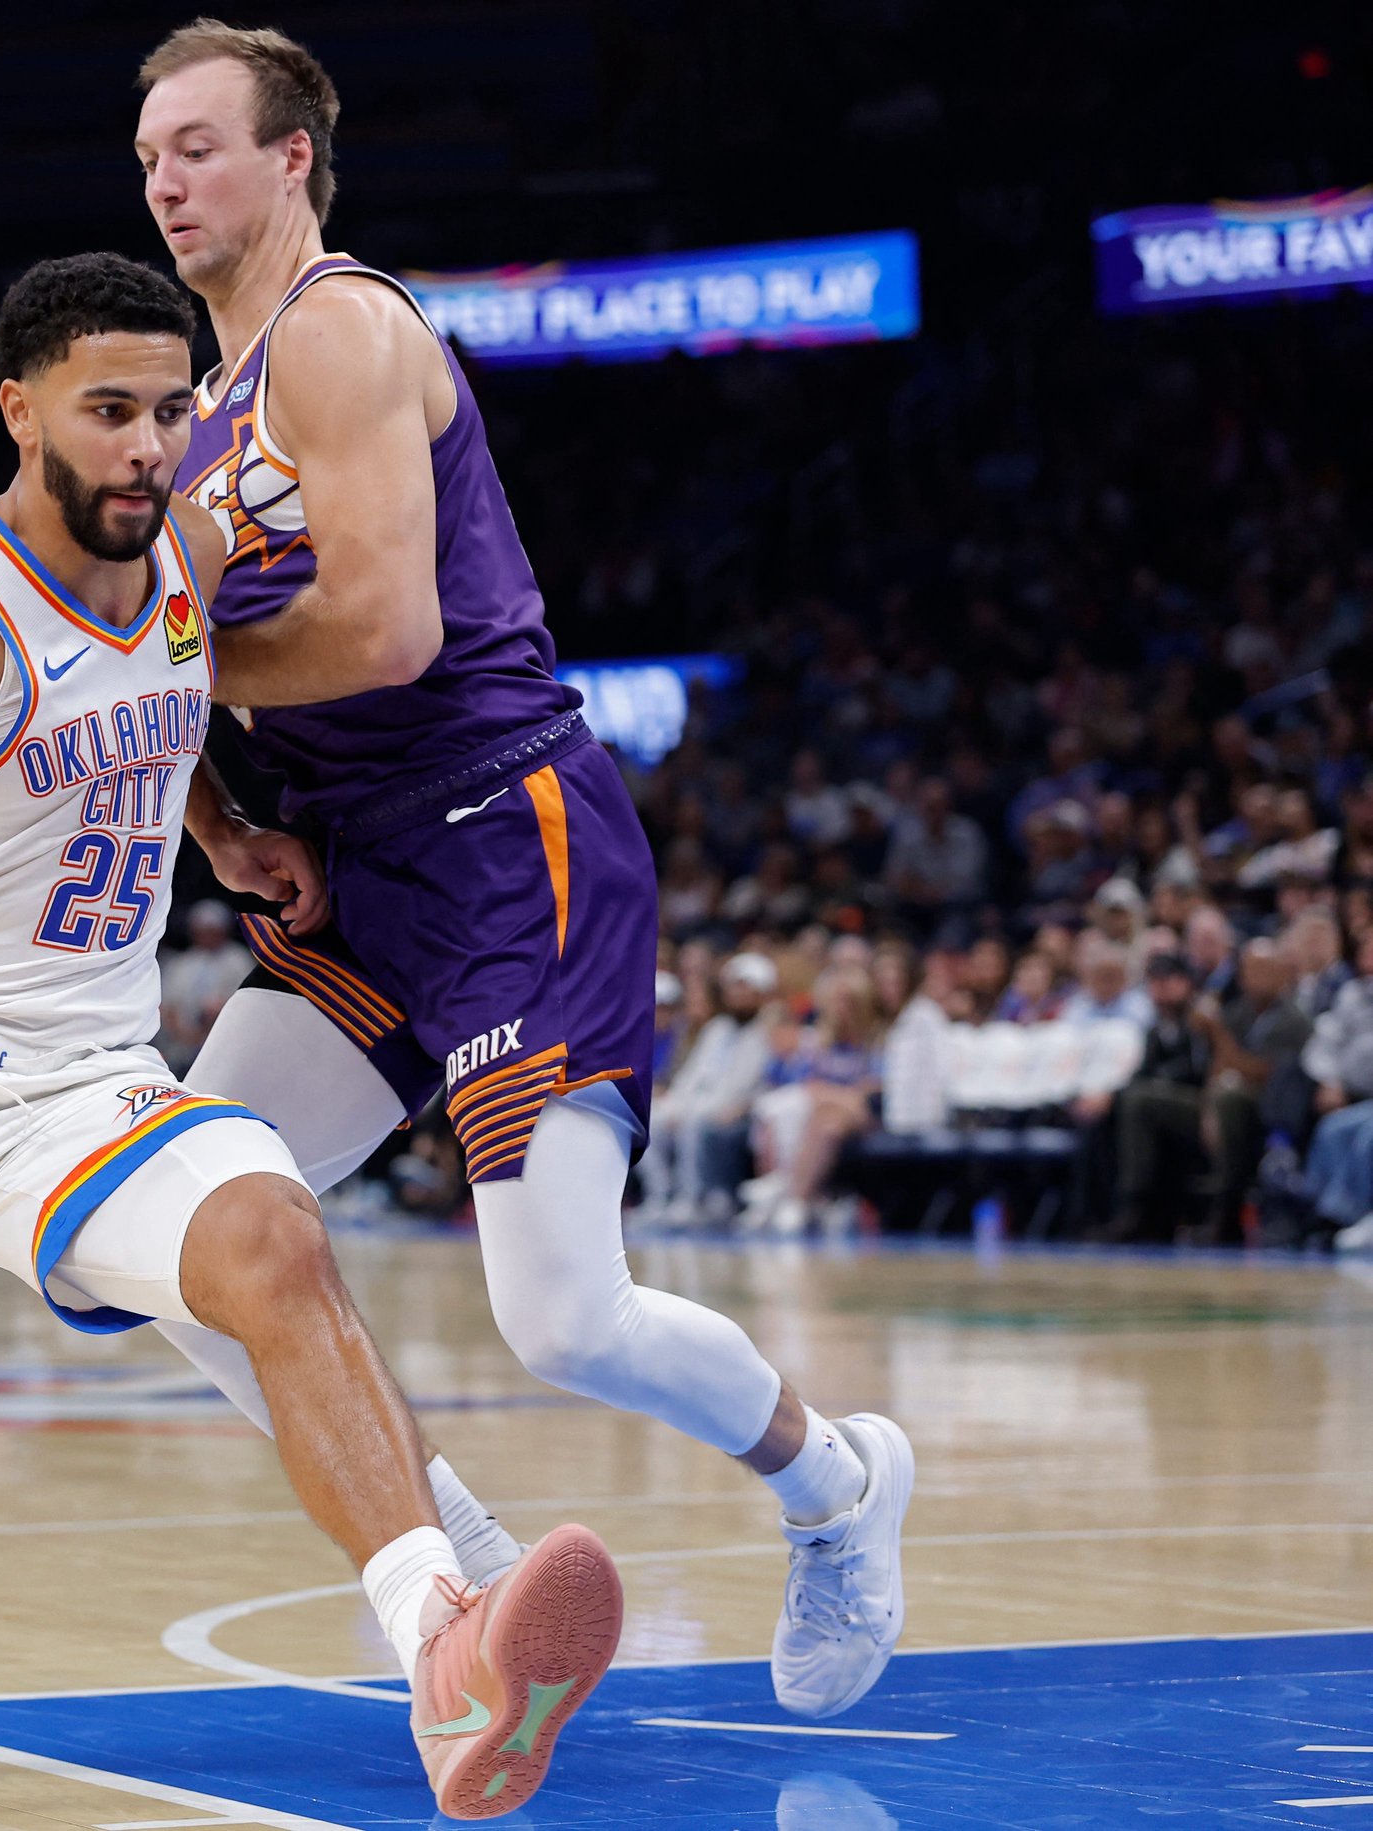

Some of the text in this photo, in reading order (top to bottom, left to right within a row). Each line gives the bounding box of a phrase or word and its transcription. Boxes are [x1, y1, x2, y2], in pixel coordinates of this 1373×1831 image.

[1133, 228, 1279, 290] YOUR
[541, 276, 691, 343] PLACE
[697, 274, 759, 330] TO
[764, 259, 881, 324] PLAY
[80, 762, 178, 829] CITY
[31, 828, 167, 953] 25
